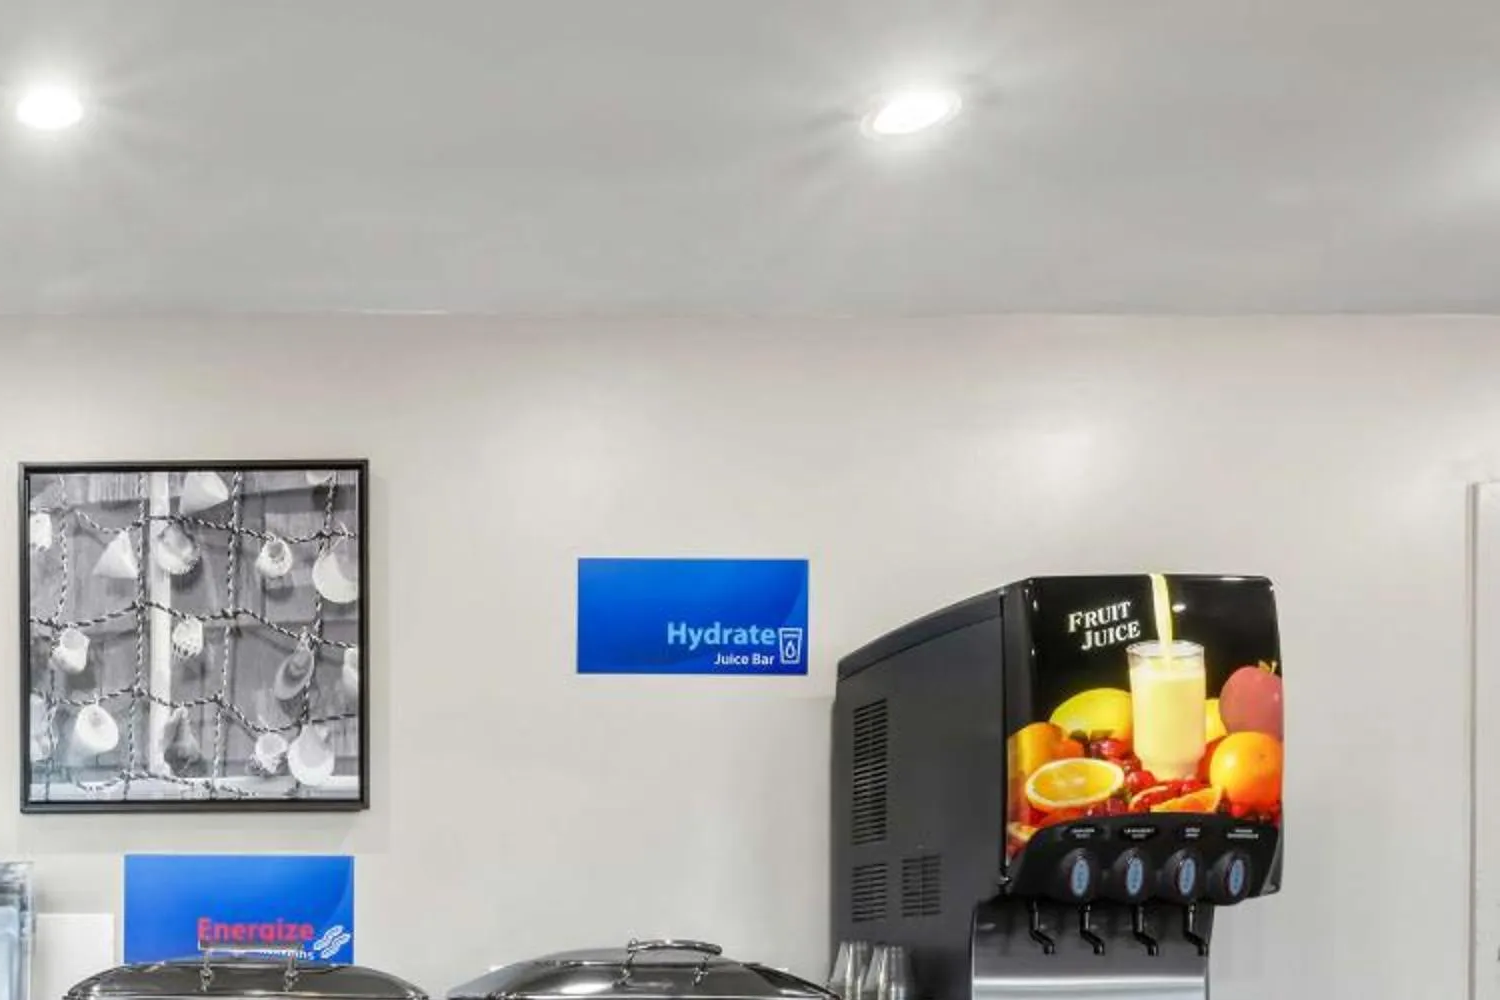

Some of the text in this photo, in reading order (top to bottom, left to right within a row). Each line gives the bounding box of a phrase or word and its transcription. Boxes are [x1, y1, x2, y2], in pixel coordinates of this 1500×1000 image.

[1068, 601, 1131, 633] FRUIT
[667, 621, 776, 651] Hydrate
[1081, 620, 1141, 651] JUICE
[713, 653, 775, 665] Juice Bar
